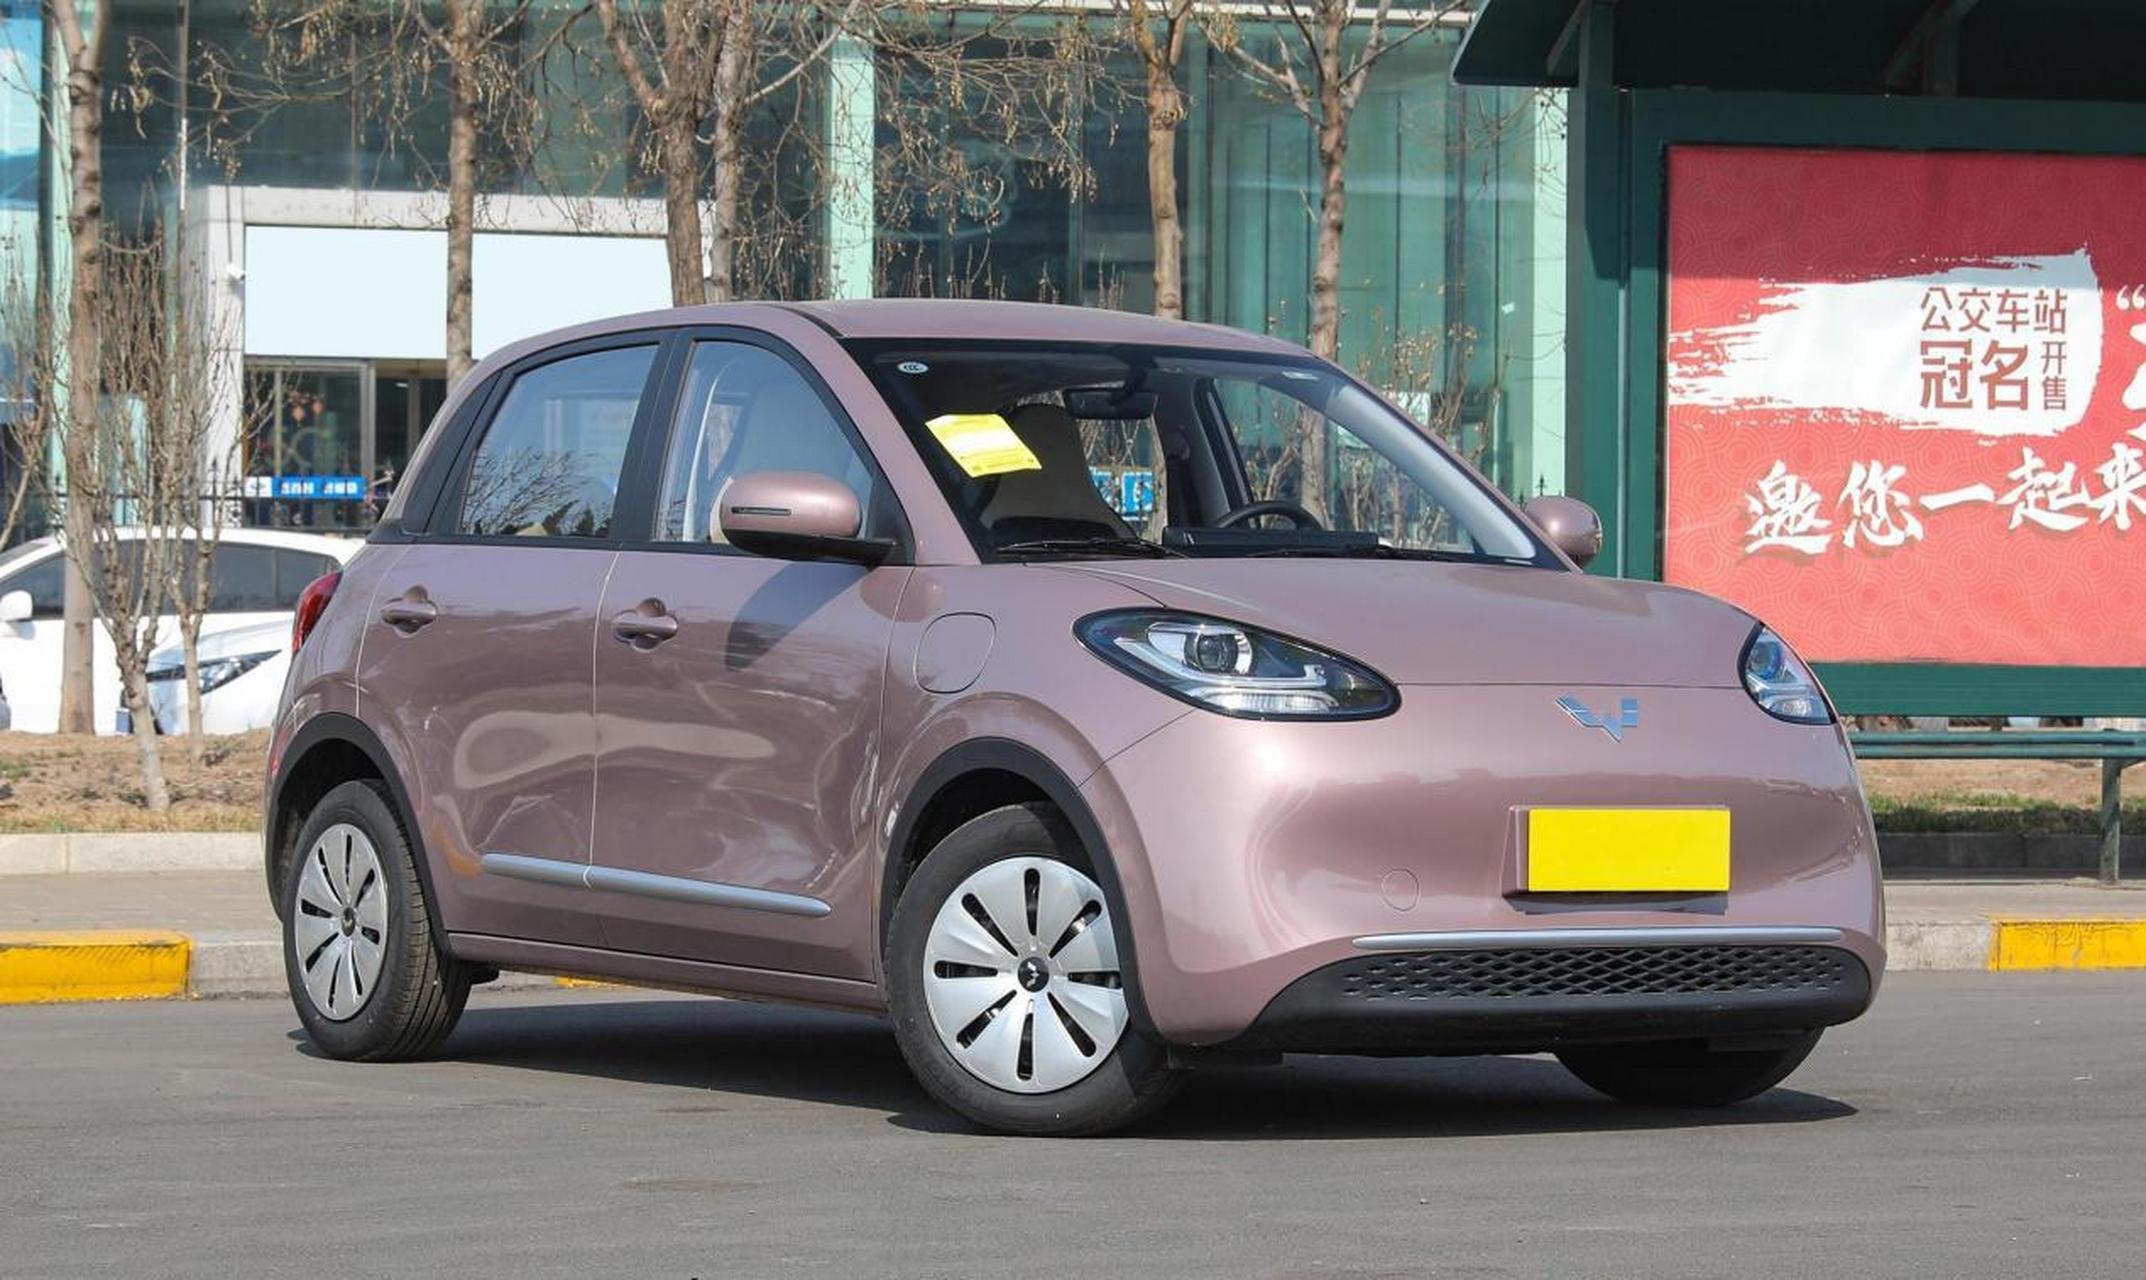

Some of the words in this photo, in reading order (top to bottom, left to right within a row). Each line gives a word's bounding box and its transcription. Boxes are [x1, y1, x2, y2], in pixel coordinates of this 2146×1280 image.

[1920, 286, 2068, 334] 公交车站
[1920, 338, 2029, 411] 冠名
[2041, 340, 2067, 411] 开售
[1745, 443, 2146, 554] 邀您一起来
